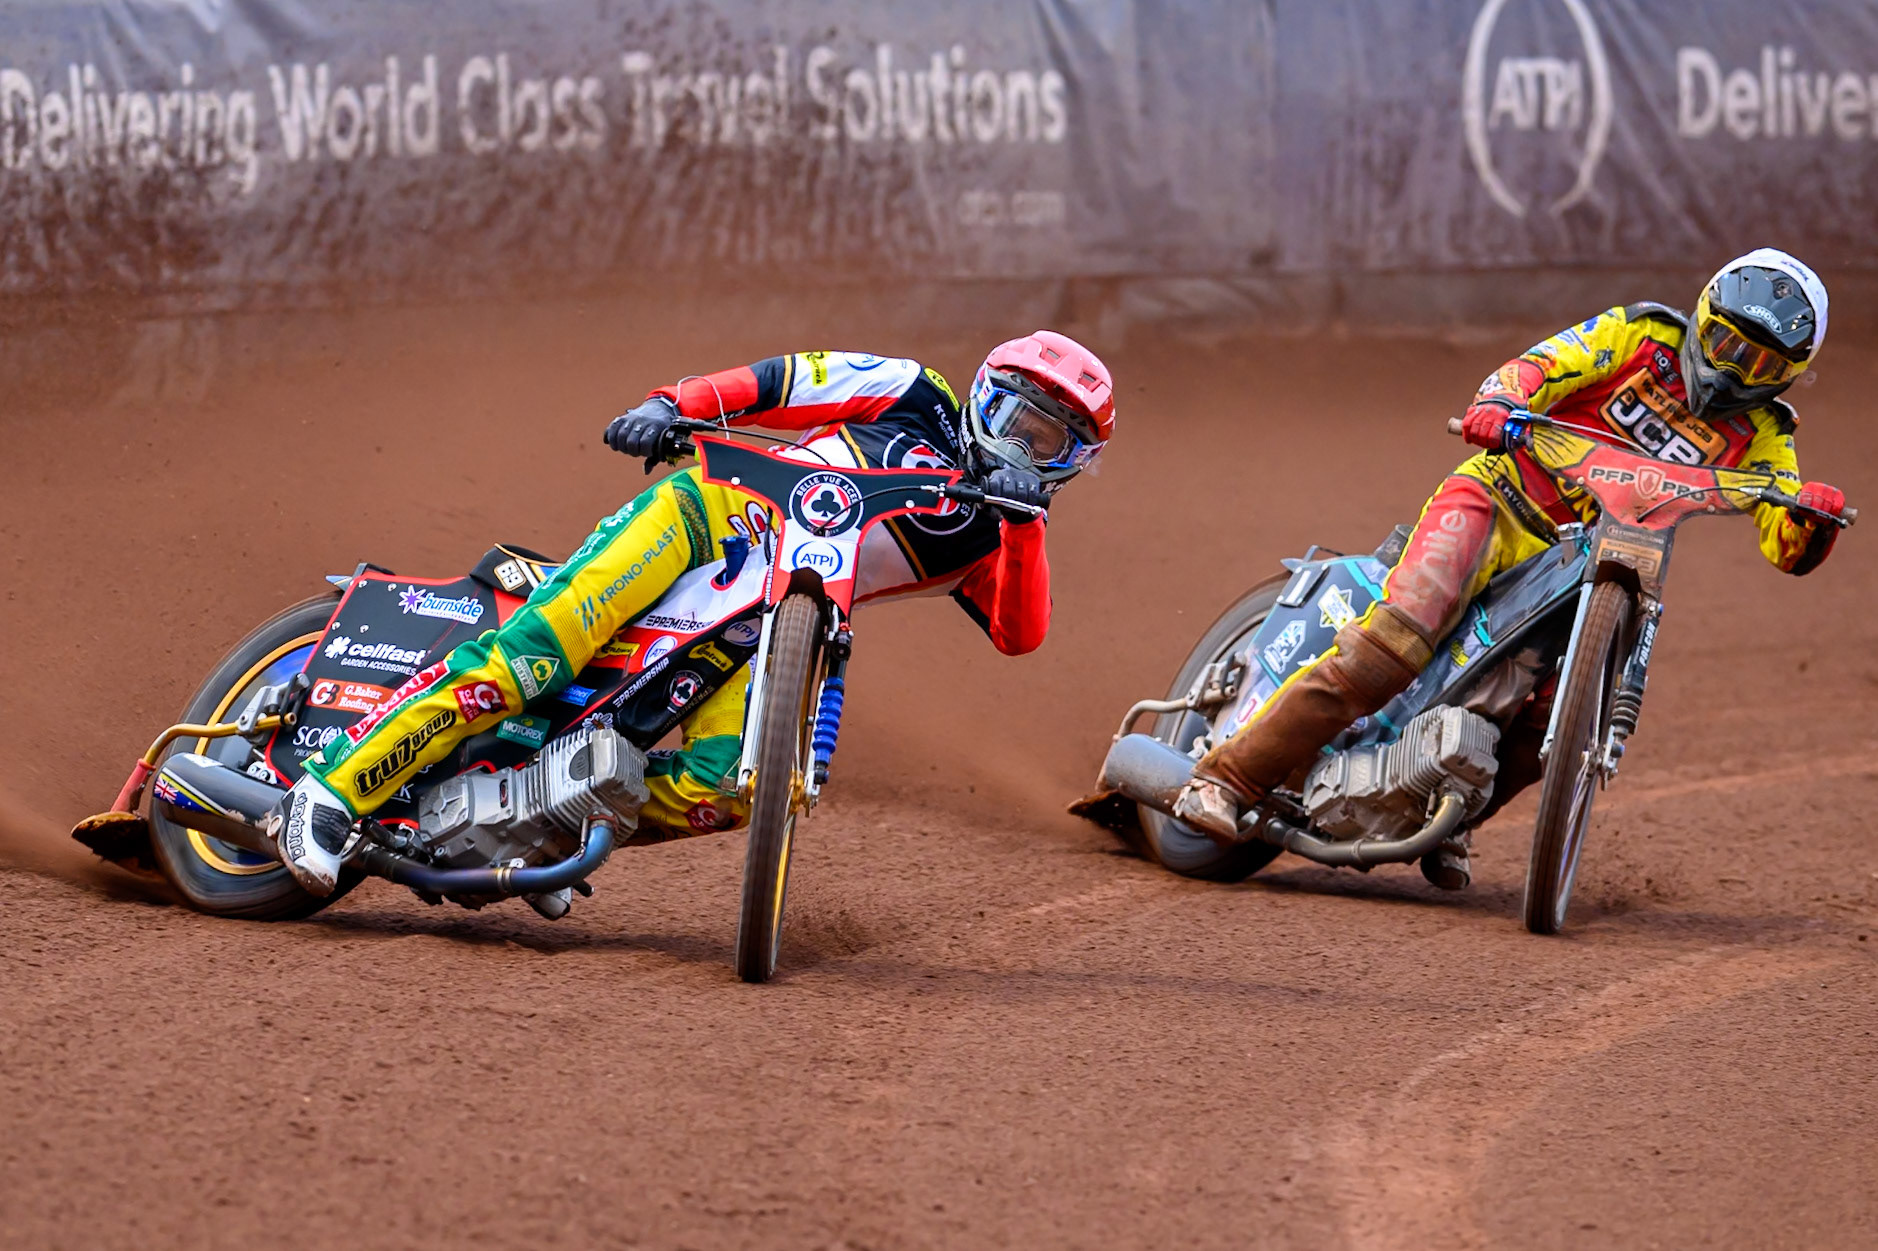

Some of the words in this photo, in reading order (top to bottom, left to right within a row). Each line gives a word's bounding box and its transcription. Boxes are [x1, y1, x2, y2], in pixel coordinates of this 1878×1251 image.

[1489, 56, 1586, 131] ATPI
[0, 62, 258, 193] Delivering
[268, 54, 438, 162] World
[458, 52, 610, 157] Class
[622, 45, 789, 149] Travel
[805, 44, 1069, 143] Solutions
[1749, 305, 1779, 330] SHOEI
[1687, 423, 1713, 443] JCB
[795, 475, 821, 498] BELLE
[822, 474, 842, 486] VUE
[841, 480, 860, 504] ACES
[1590, 468, 1634, 483] PFP
[1661, 481, 1706, 502] PRO
[598, 524, 678, 606] KRONO-PLAST
[800, 553, 834, 568] ATPI
[422, 594, 482, 618] burnside
[348, 640, 427, 666] cellfast
[340, 657, 367, 669] GARDEN
[367, 659, 417, 677] ACCESSORIES
[344, 684, 383, 700] G.Baker
[338, 698, 374, 714] Roofing
[502, 720, 544, 741] MOTOREX
[288, 791, 308, 861] daytona
